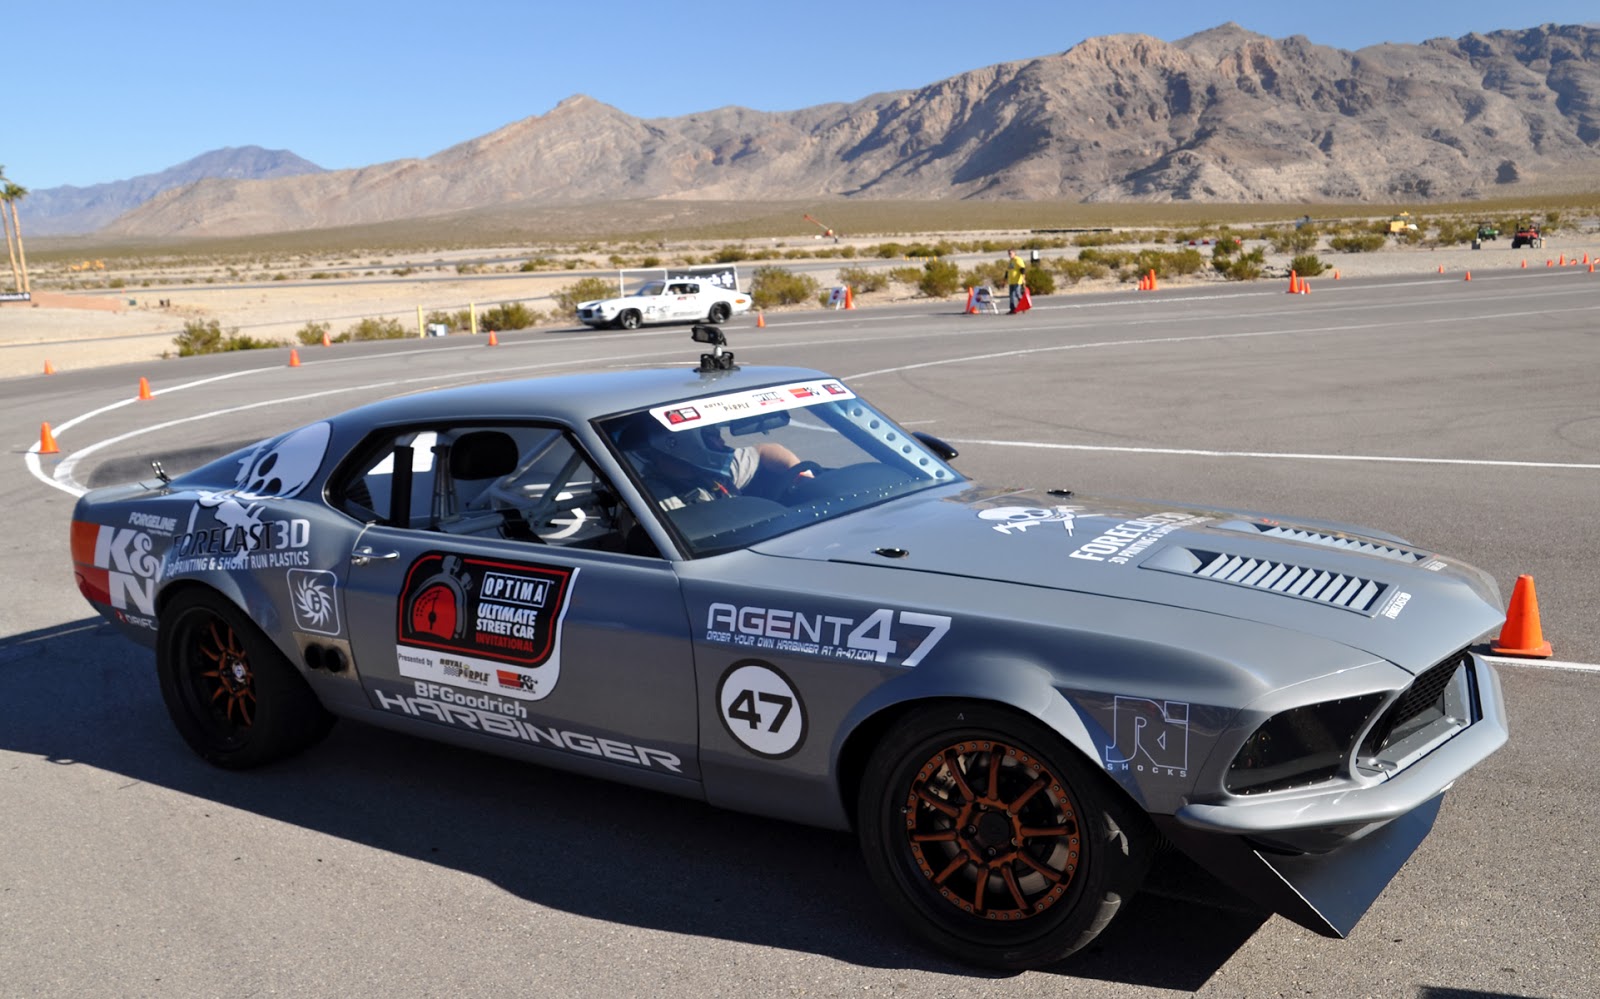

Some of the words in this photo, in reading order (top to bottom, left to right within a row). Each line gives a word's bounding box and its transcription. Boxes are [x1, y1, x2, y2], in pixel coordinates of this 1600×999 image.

[128, 511, 177, 531] FORGELINE
[173, 519, 310, 557] FORECAST3D
[1069, 512, 1195, 561] FOREC
[172, 558, 208, 575] PRINTING
[209, 557, 216, 571] &
[217, 556, 249, 571] SHORT
[251, 555, 267, 569] RUN
[269, 551, 309, 567] PLASTICS
[484, 577, 543, 602] OPTIMA
[477, 602, 538, 626] ULTIMATE
[476, 618, 512, 636] STREET
[512, 624, 535, 640] CAR
[476, 631, 534, 652] INVITATIONAL
[706, 630, 731, 642] ORDER
[734, 633, 754, 646] YOUR
[757, 637, 774, 649] OWN
[776, 640, 819, 654] HARBINGER
[821, 645, 832, 656] AT
[836, 648, 874, 662] A-47.COM
[398, 653, 425, 665] Presented
[426, 658, 433, 667] by
[439, 658, 463, 668] ROYAL
[458, 668, 490, 682] PURPLE
[414, 681, 527, 719] BFGoodrich
[728, 689, 793, 733] 47
[374, 689, 683, 774] HARBINGER
[1107, 763, 1187, 778] SHOCKS
